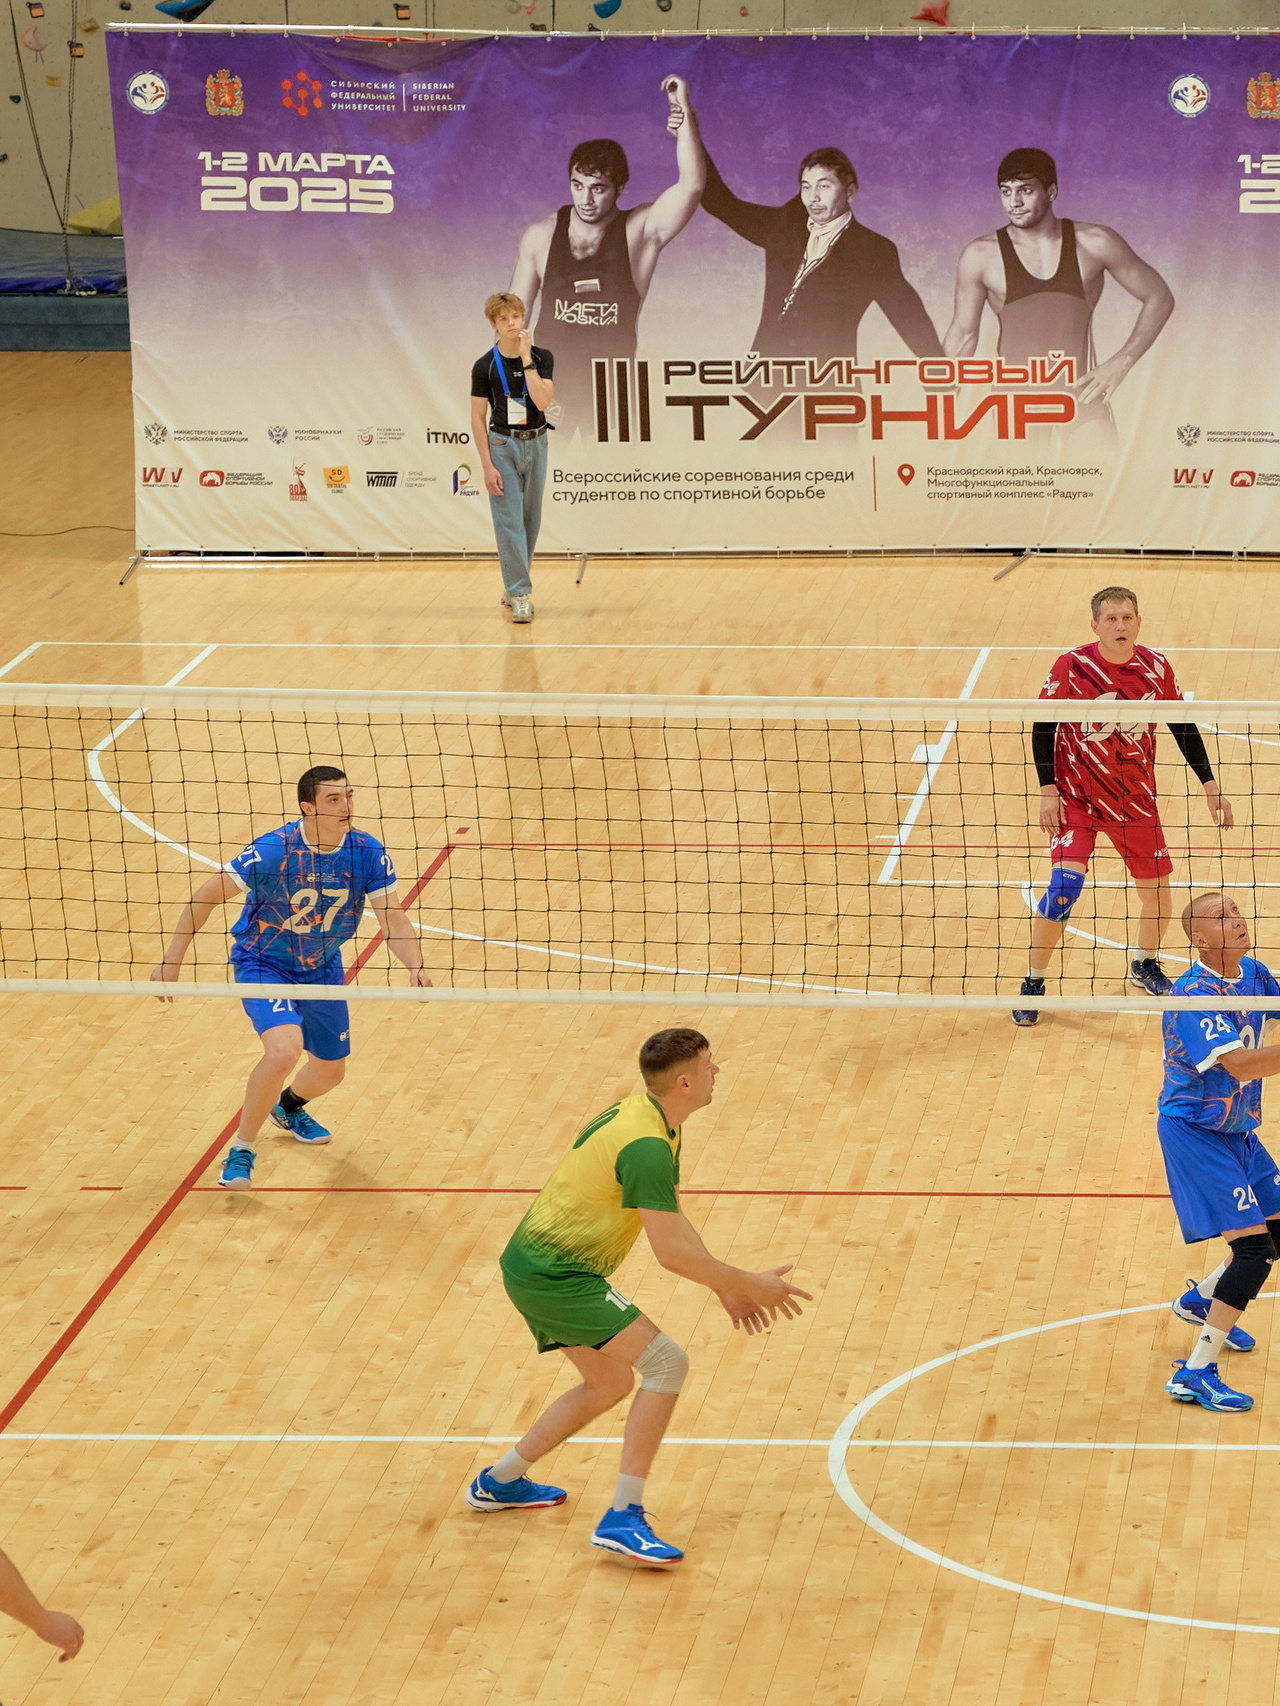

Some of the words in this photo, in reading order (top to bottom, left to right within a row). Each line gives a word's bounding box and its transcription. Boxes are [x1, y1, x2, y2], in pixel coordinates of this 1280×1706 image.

[330, 80, 396, 90] СИБИРСКИЙ
[412, 82, 455, 90] SIBERIAN
[330, 91, 396, 101] ФЕДЕРАЛЬНЫЙ
[412, 93, 452, 101] FEDERAL
[330, 103, 396, 112] УНИВЕРСИТЕТ
[412, 103, 467, 112] UNIVERSITY
[197, 151, 248, 172] 1-2
[258, 151, 396, 175] МАРТА
[200, 176, 396, 215] 2025
[554, 298, 619, 317] NAFTA
[662, 351, 1076, 387] РЕЙТИНГОВЫЙ
[592, 358, 653, 443] III
[663, 392, 1077, 442] ТУРНИР
[553, 468, 681, 485] Всероссийские
[685, 469, 801, 484] соревнования
[804, 470, 855, 484] среди
[927, 466, 1004, 478] Красноярский
[1005, 466, 1034, 478] край,
[1036, 465, 1103, 478] Красноярск,
[927, 477, 1055, 489] Многофункциональный
[552, 489, 637, 504] студентов
[640, 490, 660, 501] по
[663, 486, 762, 503] спортивной
[765, 486, 826, 503] борьбе
[926, 489, 992, 501] спортивный
[991, 489, 1045, 500] комплекс
[1046, 489, 1094, 500] «Радуга»
[237, 844, 263, 869] 27
[281, 888, 350, 934] 27
[1200, 1013, 1232, 1042] 24
[1232, 1184, 1259, 1212] 24
